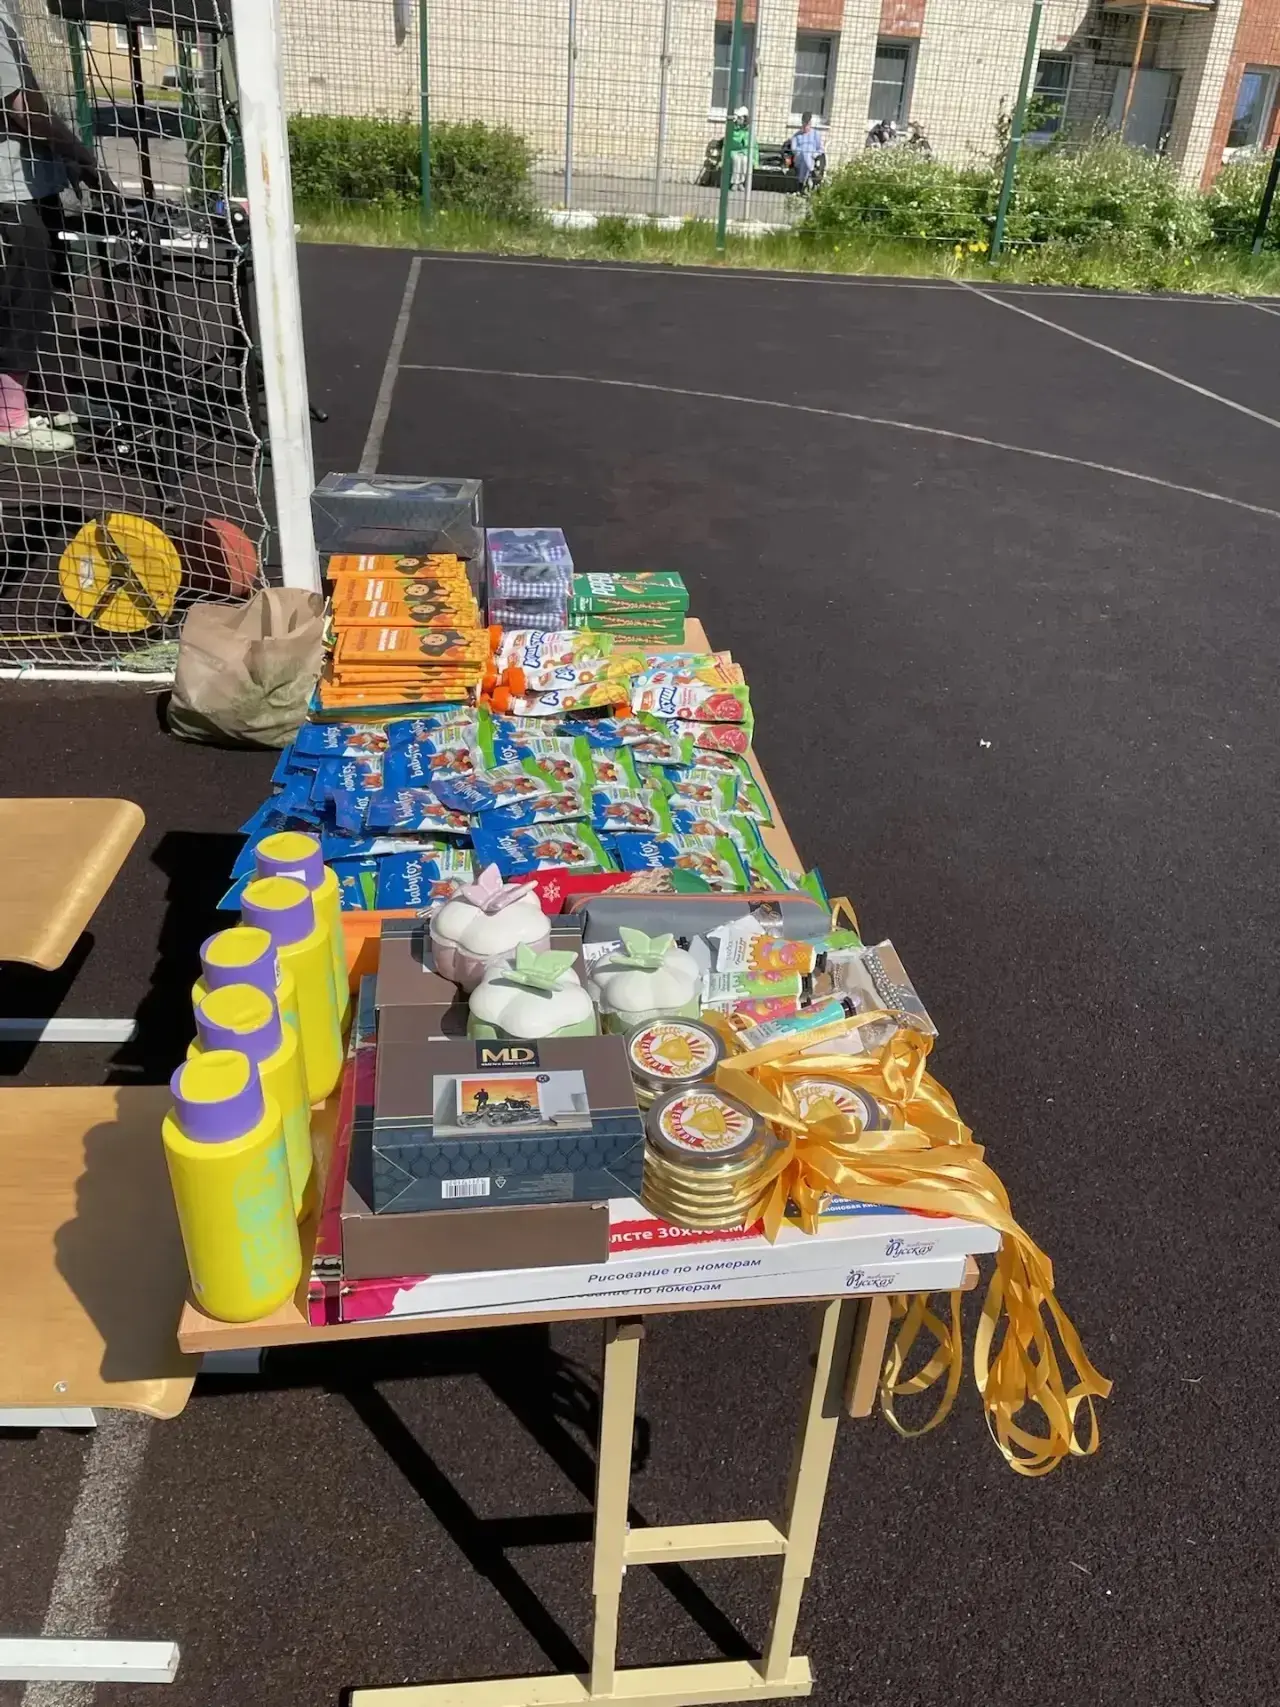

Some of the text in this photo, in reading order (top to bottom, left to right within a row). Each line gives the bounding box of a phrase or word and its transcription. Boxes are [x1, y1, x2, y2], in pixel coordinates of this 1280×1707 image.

[404, 743, 424, 778] babyfox
[639, 840, 666, 871] byfox
[402, 860, 422, 905] babyfox
[482, 1048, 535, 1062] MD
[609, 1232, 653, 1244] лсте
[885, 1240, 934, 1258] Русская
[588, 1259, 762, 1283] Рисование по номерам
[656, 1283, 722, 1294] номерам
[846, 1273, 895, 1289] Русская
